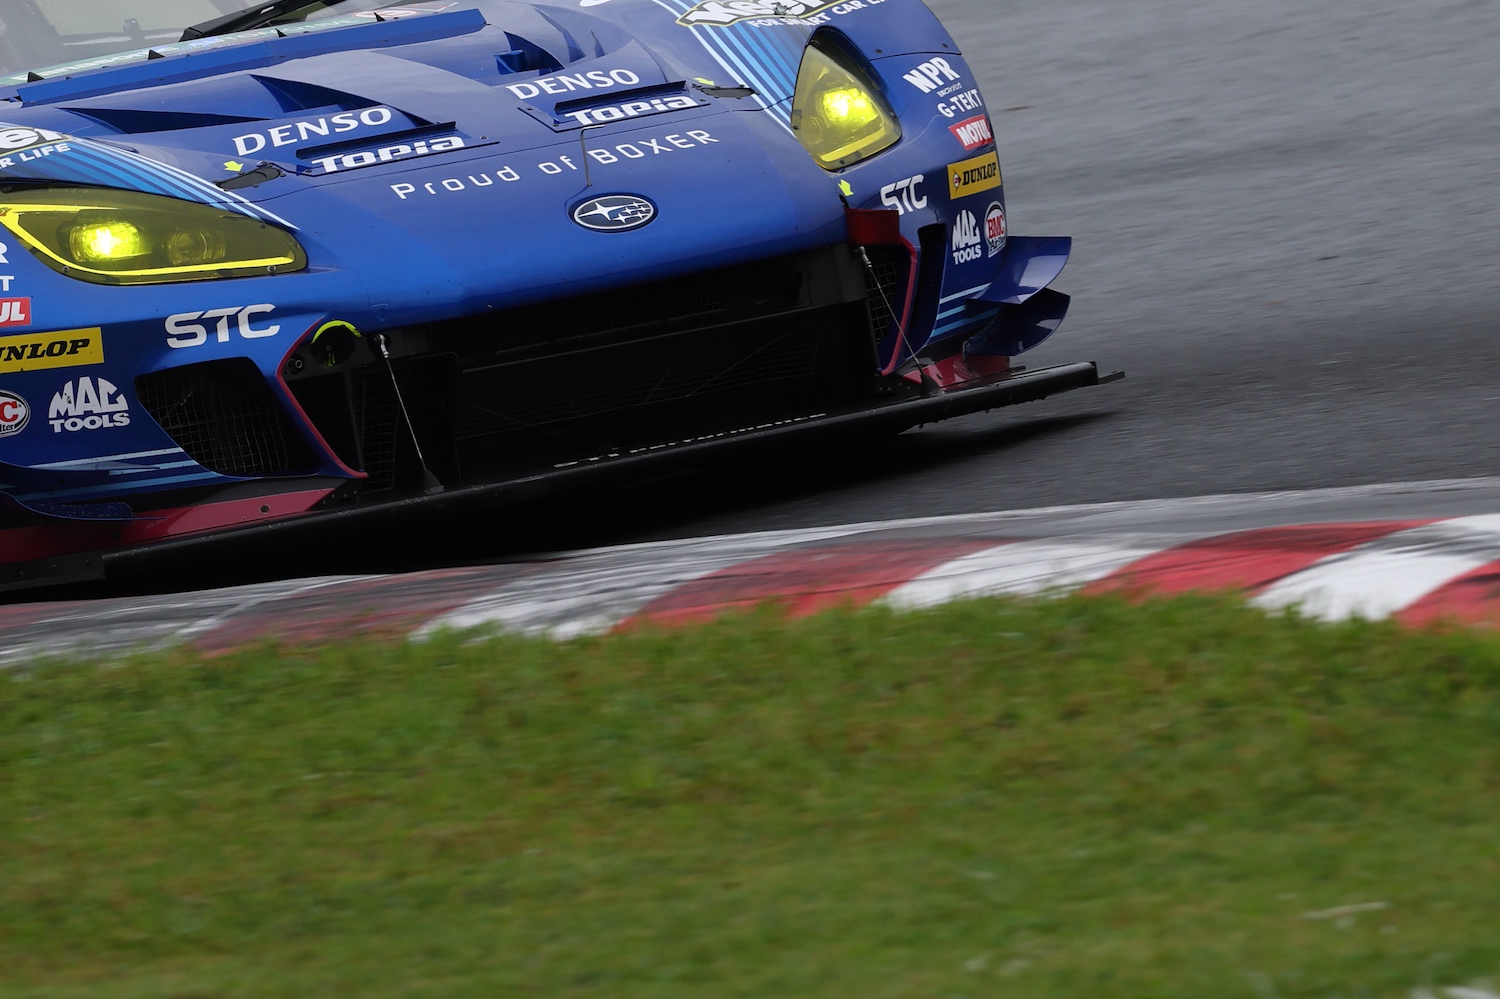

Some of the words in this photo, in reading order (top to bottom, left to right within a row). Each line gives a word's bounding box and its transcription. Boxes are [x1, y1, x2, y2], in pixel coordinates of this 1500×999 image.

[747, 17, 778, 28] FOR
[783, 12, 832, 28] SMART
[832, 0, 868, 15] CAR
[507, 67, 640, 100] DENSO
[902, 56, 961, 93] NPR
[936, 88, 982, 118] G-TEKT
[232, 107, 393, 156] DENSO
[955, 118, 991, 147] MOTUL
[20, 142, 73, 163] LIFE
[390, 164, 520, 200] Proud
[539, 154, 584, 177] of
[592, 129, 720, 166] BOXER
[962, 162, 997, 186] DUNLOP
[880, 173, 927, 215] STC
[952, 209, 981, 250] MAC
[953, 245, 982, 265] TOOLS
[164, 303, 280, 349] STC
[48, 376, 129, 419] MAC
[49, 412, 130, 433] TOOLS
